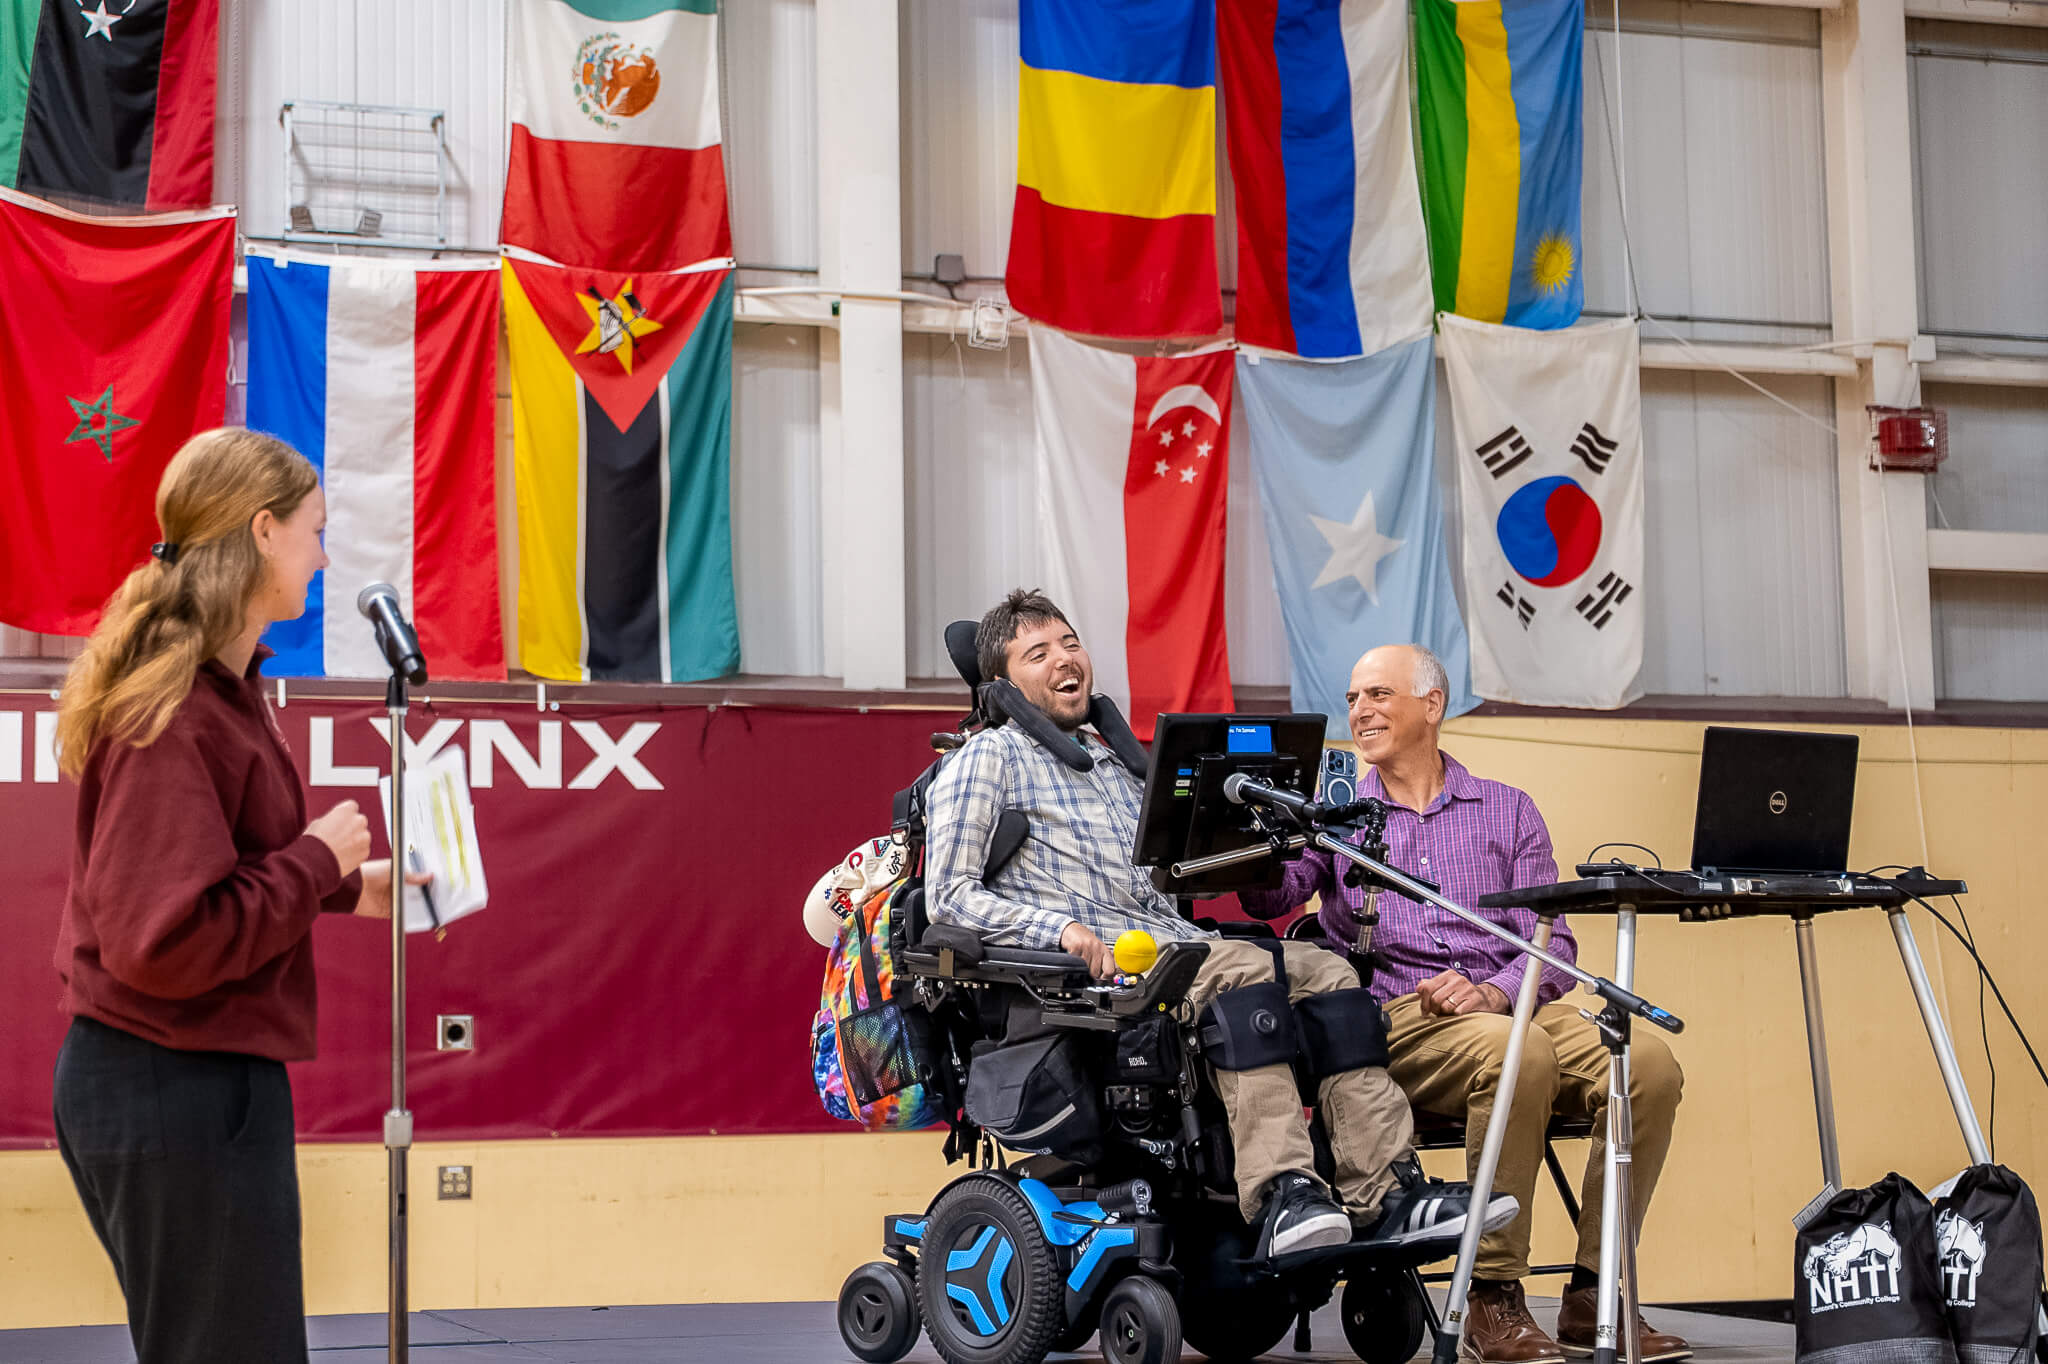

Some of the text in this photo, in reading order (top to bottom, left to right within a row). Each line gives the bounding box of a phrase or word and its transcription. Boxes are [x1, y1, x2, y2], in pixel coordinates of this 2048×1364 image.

[309, 716, 665, 790] LYNX
[1810, 1263, 1899, 1308] NHTI
[1839, 1297, 1874, 1308] Community
[1875, 1295, 1901, 1303] College
[1953, 1299, 1976, 1308] College
